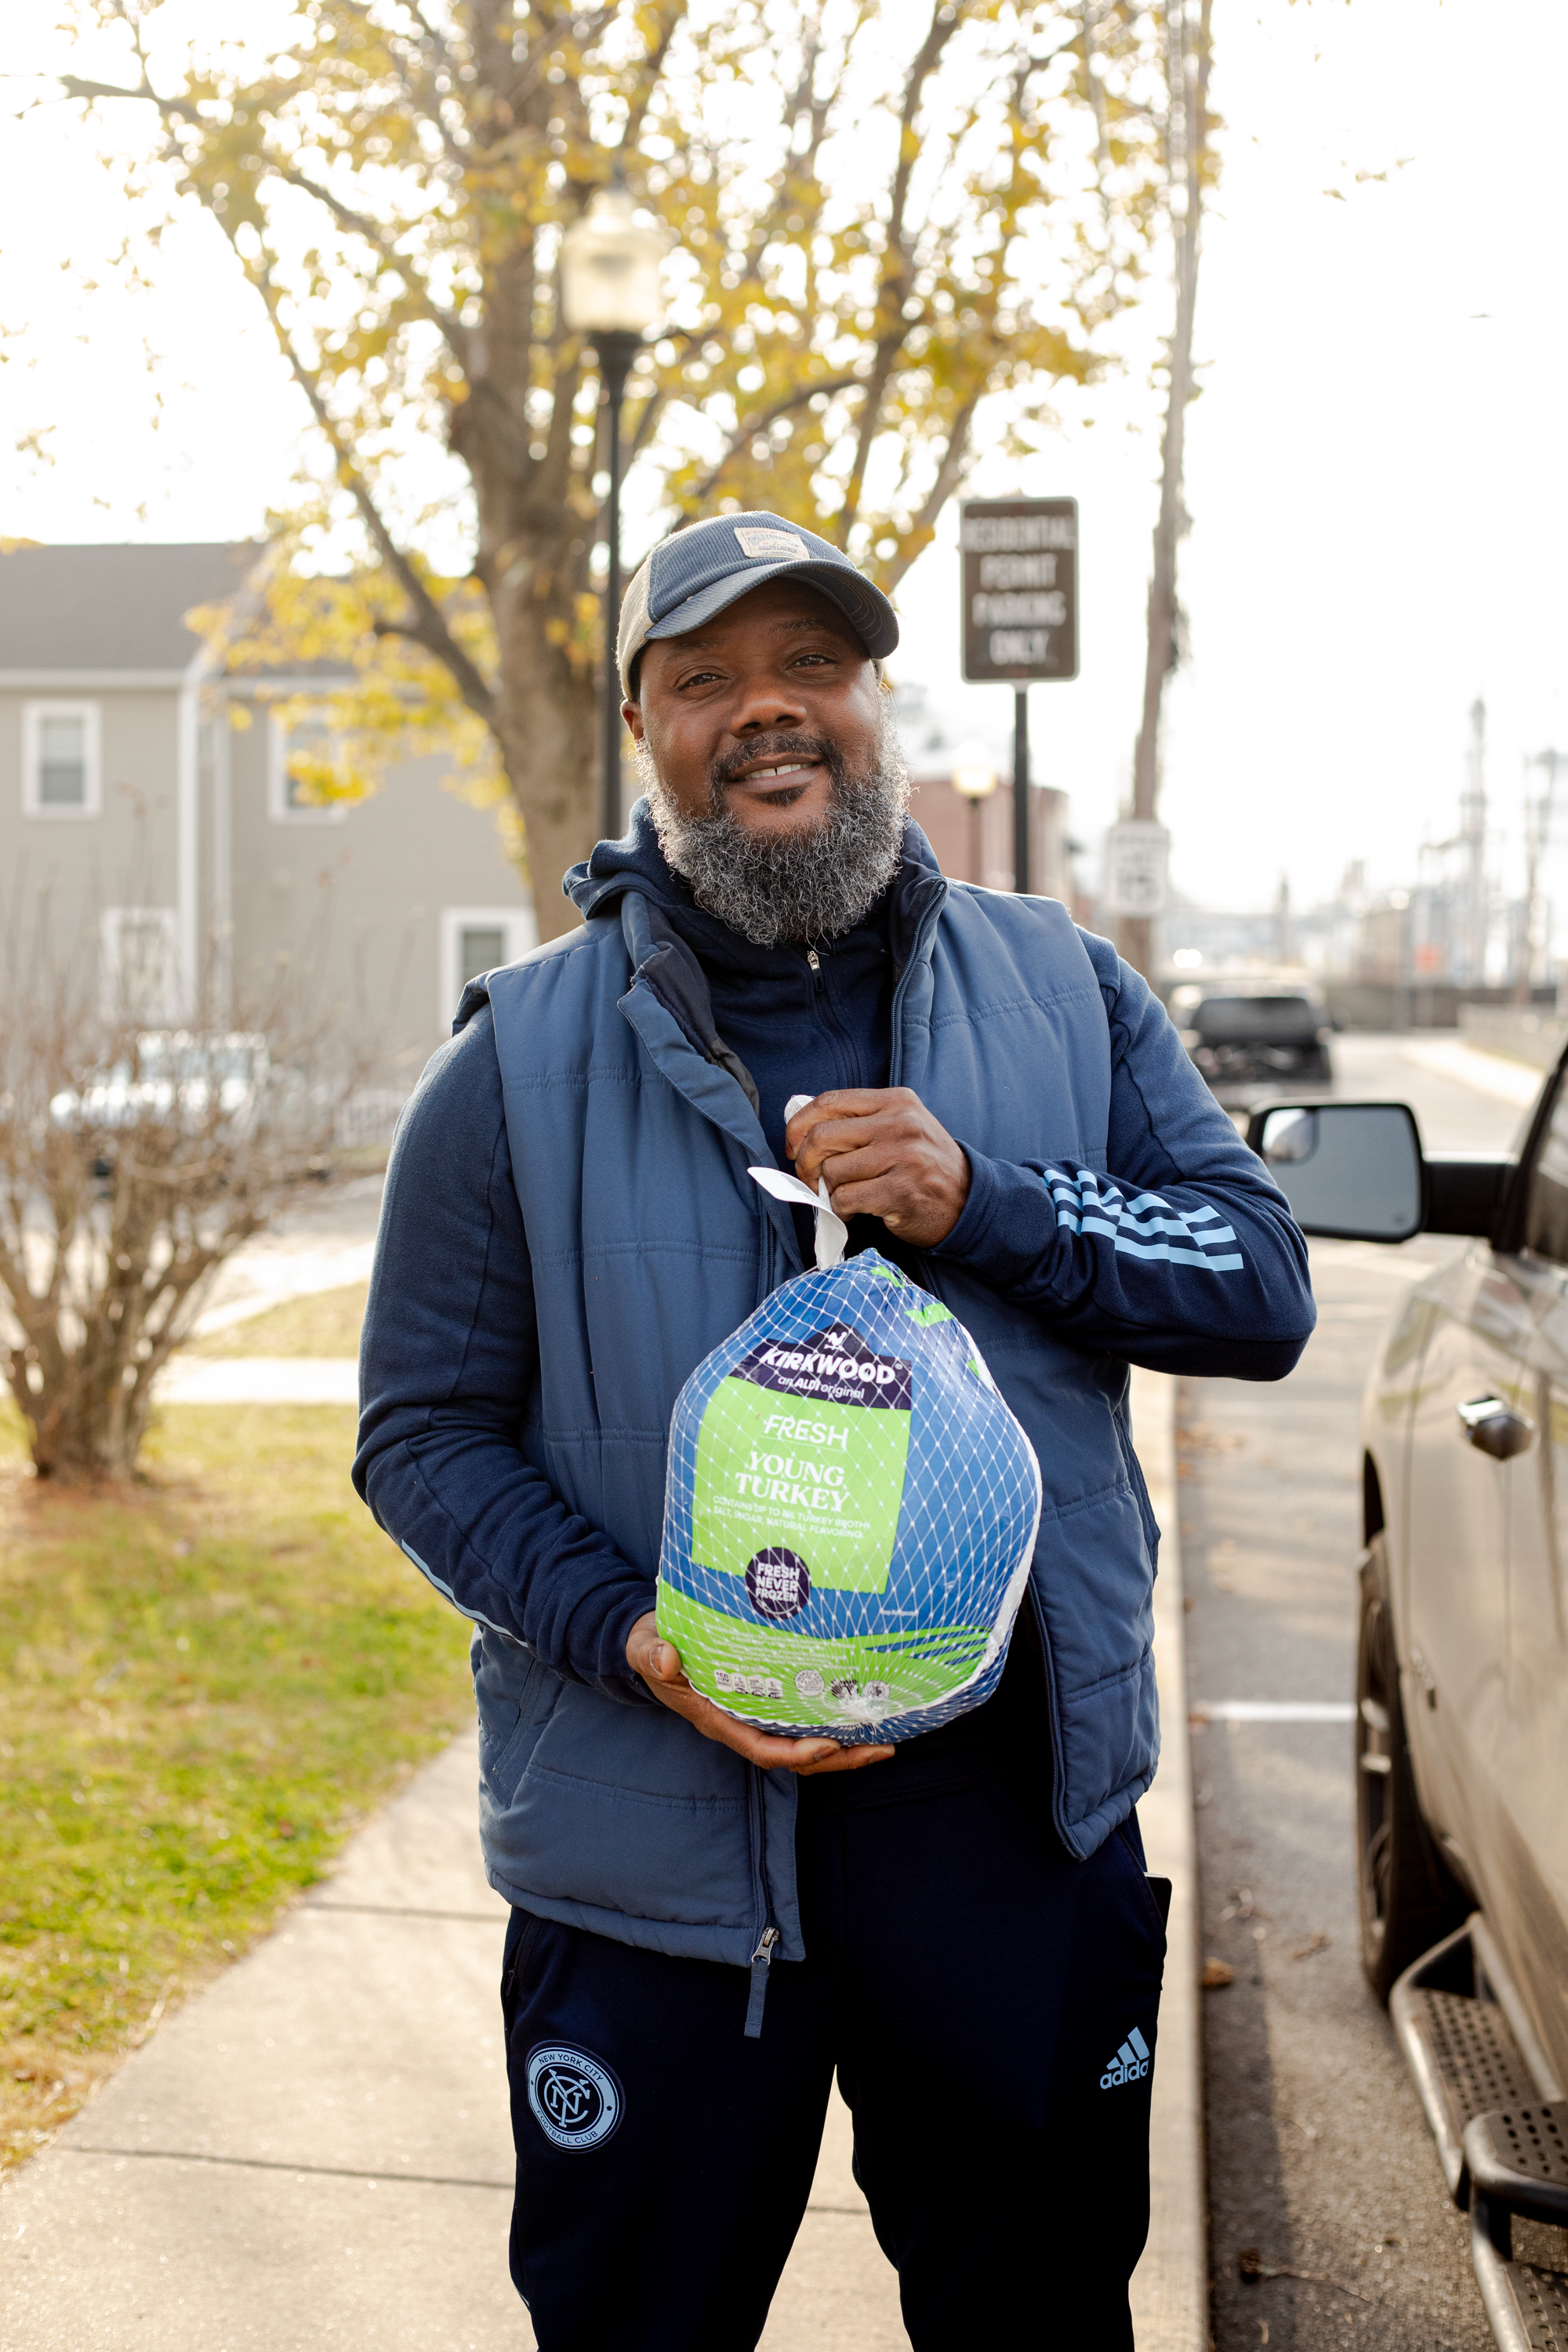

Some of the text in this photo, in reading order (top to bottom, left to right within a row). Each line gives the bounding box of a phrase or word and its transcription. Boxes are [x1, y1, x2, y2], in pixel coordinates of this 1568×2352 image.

[989, 630, 1049, 665] ONLY
[759, 1348, 895, 1385] KIRKWOOD
[778, 1377, 865, 1399] an ALDI original
[764, 1414, 849, 1449] FRESH
[750, 1451, 845, 1486] YOUNG
[735, 1472, 851, 1512] TURKEY
[713, 1496, 753, 1511] CONTAINS
[754, 1504, 767, 1513] UP
[768, 1507, 780, 1516] TO
[797, 1512, 833, 1525] TURKEY
[766, 1517, 807, 1533] NATURAL
[756, 1575, 800, 1592] NEVER
[757, 1563, 800, 1581] FRESH
[755, 1587, 798, 1602] FROZEN
[539, 2053, 604, 2082] NEW YORK CITY
[1099, 2059, 1149, 2090] adida
[536, 2110, 599, 2144] FOOTBALL CLUB
